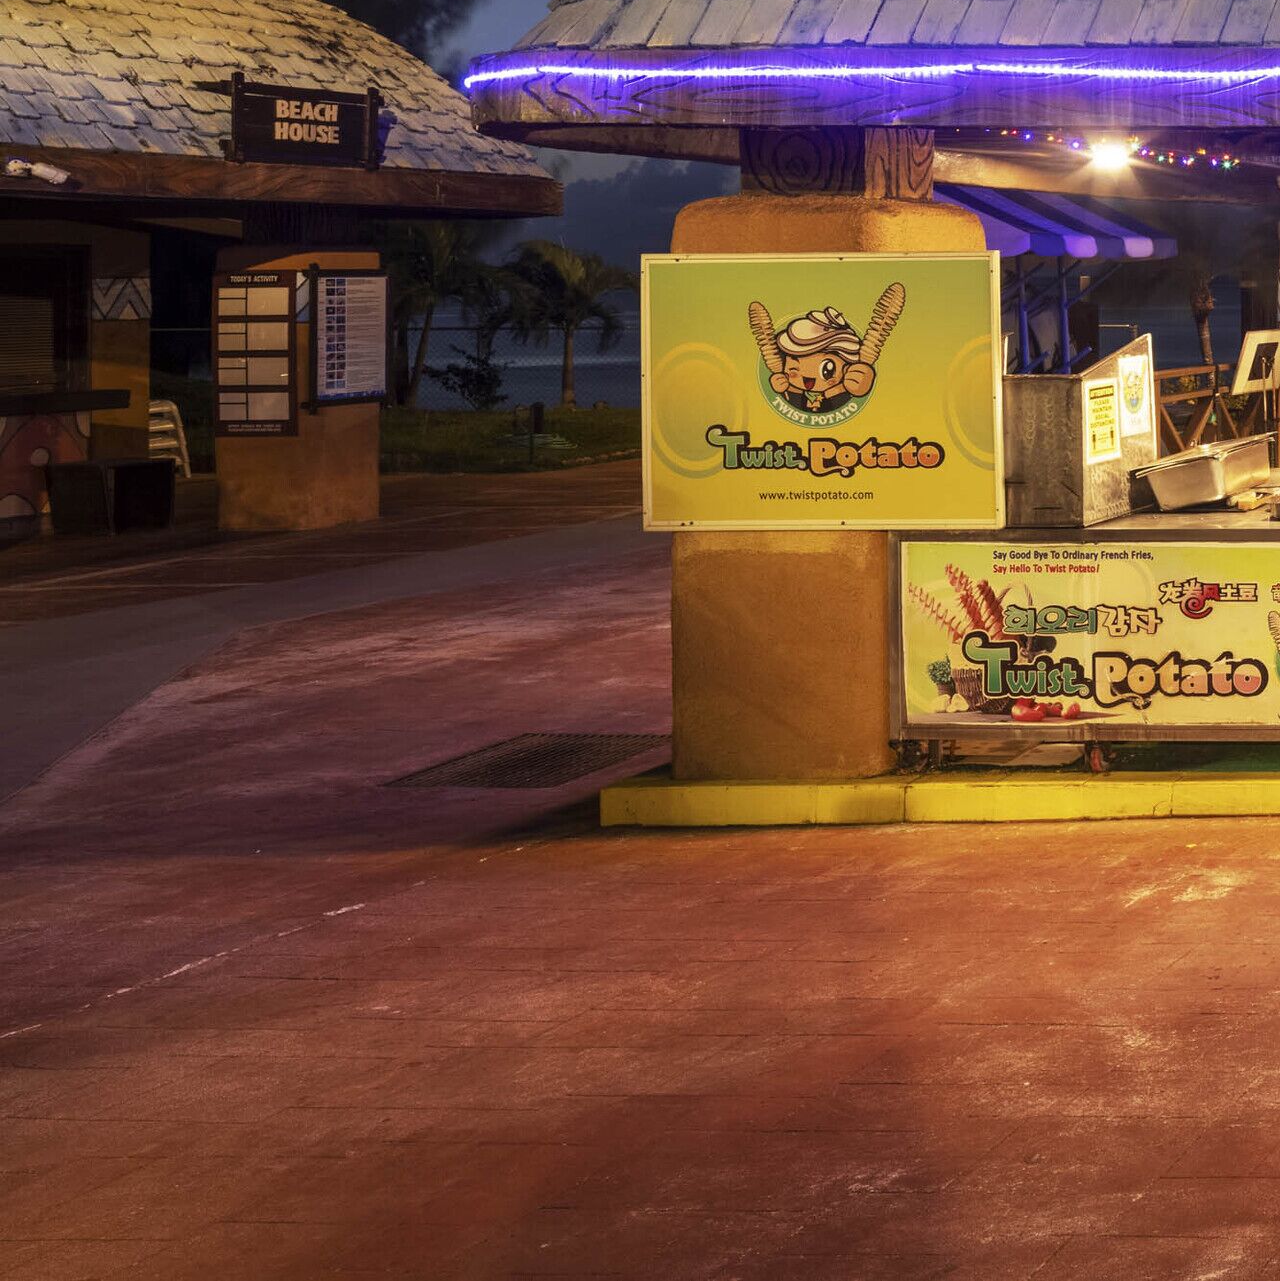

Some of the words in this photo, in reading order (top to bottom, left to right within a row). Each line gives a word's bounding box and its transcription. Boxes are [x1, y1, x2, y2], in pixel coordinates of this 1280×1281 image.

[275, 100, 339, 122] BEACH
[274, 122, 340, 144] HOUSE
[772, 397, 808, 425] TWIST
[810, 402, 859, 426] POTATO
[706, 425, 807, 470] Twist
[808, 437, 945, 478] Potato
[759, 489, 874, 502] www.twistpotato.com
[993, 550, 1007, 561] Say
[1009, 550, 1031, 560] Good
[1033, 550, 1048, 561] Bye
[1050, 550, 1060, 559] To
[1062, 550, 1099, 561] Ordinary
[1101, 550, 1129, 560] French
[1131, 550, 1154, 561] Fries,
[993, 564, 1007, 575] Say
[1009, 564, 1031, 573] Hello
[1033, 564, 1043, 573] To
[1044, 564, 1066, 573] Twist
[962, 628, 1092, 698] Twist
[1092, 651, 1269, 709] Potato
